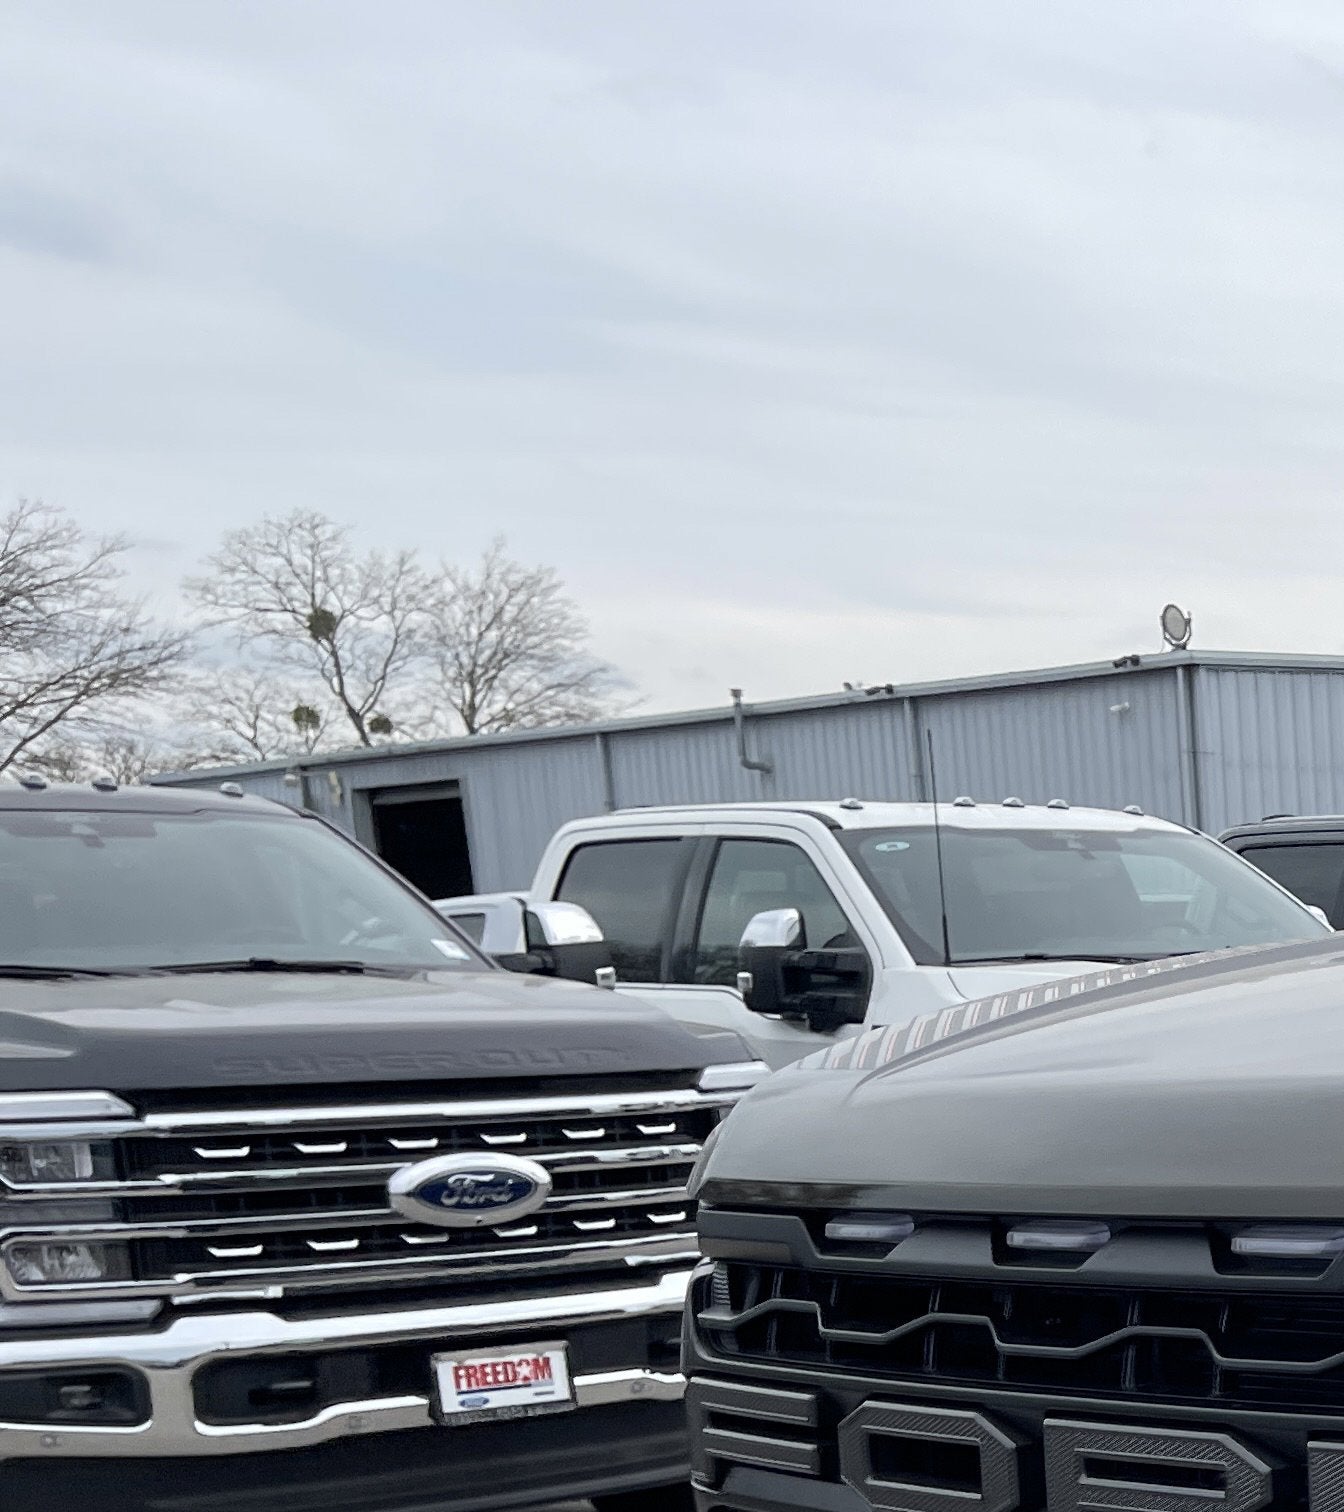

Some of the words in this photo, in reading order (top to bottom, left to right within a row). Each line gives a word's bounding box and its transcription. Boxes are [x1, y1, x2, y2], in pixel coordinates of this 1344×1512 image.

[212, 1049, 476, 1078] SUPER
[441, 1173, 514, 1206] Ford
[453, 1356, 553, 1390] FREEDOM
